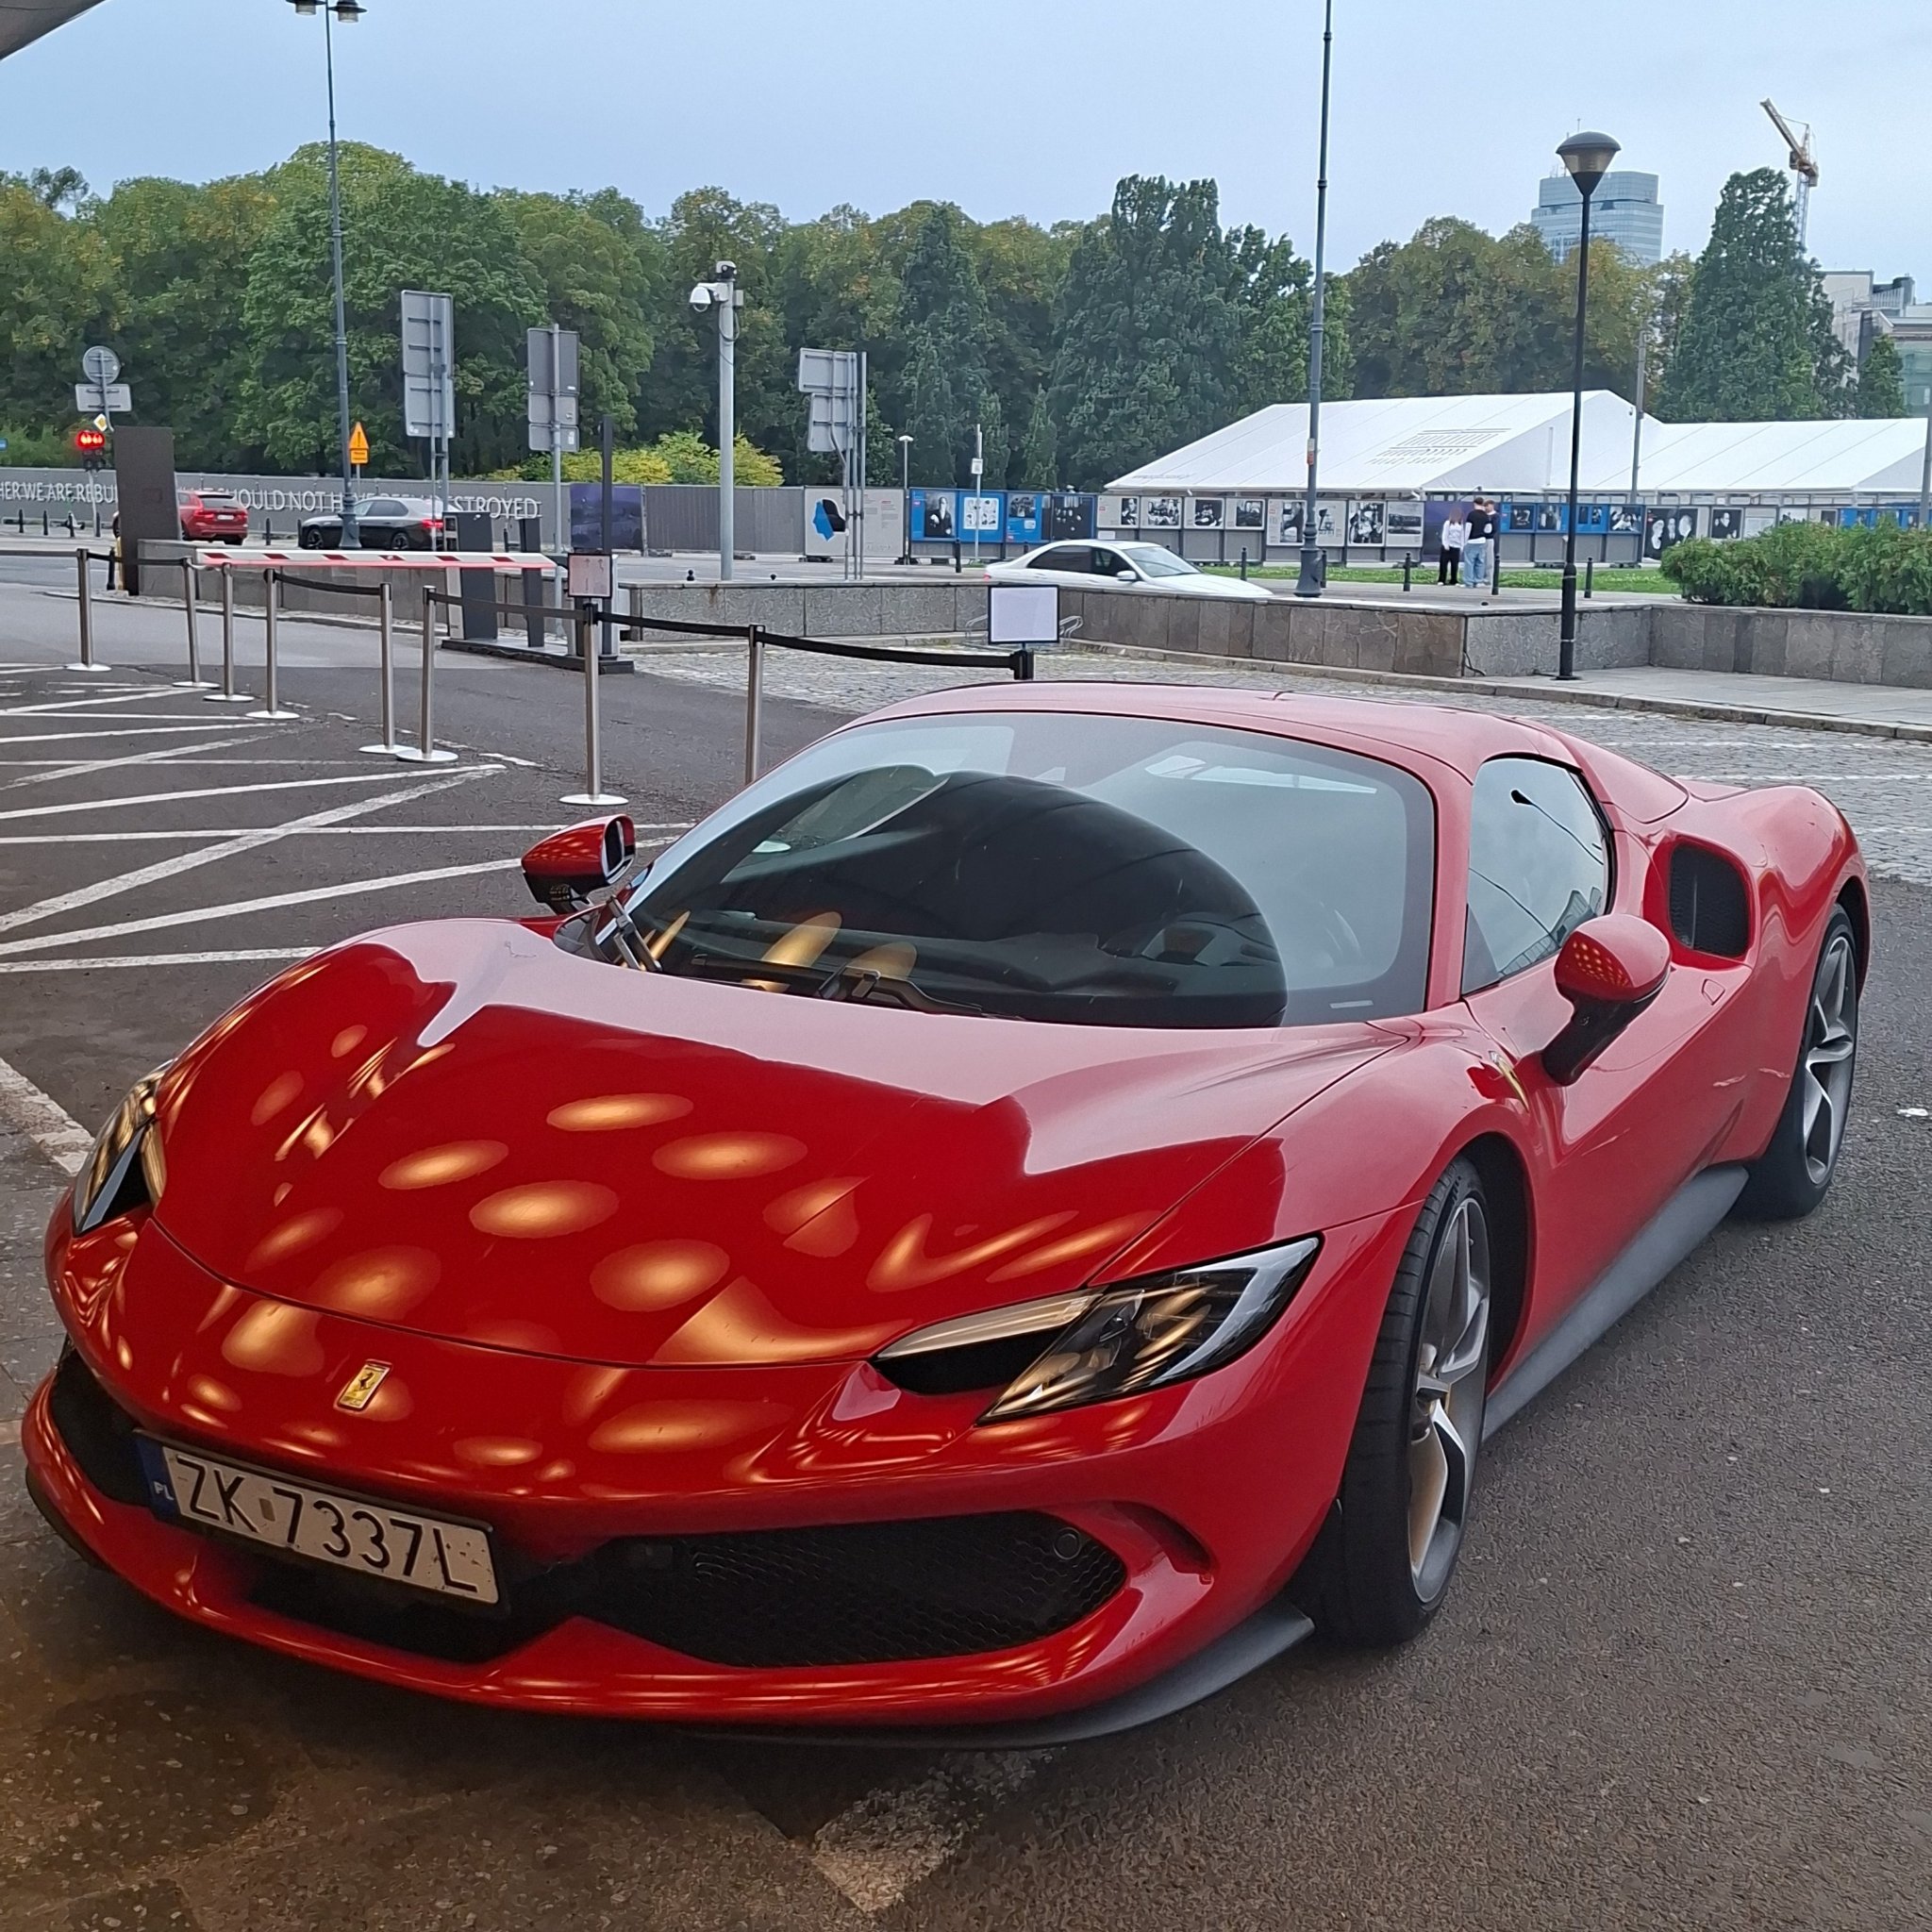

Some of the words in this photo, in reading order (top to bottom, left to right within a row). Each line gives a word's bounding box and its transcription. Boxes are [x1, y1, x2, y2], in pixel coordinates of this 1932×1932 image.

[23, 482, 44, 502] WE
[47, 483, 74, 502] ARE
[289, 490, 326, 512] NOT
[153, 1480, 175, 1501] PL
[176, 1455, 259, 1533] ZK
[272, 1486, 477, 1593] 7337L
